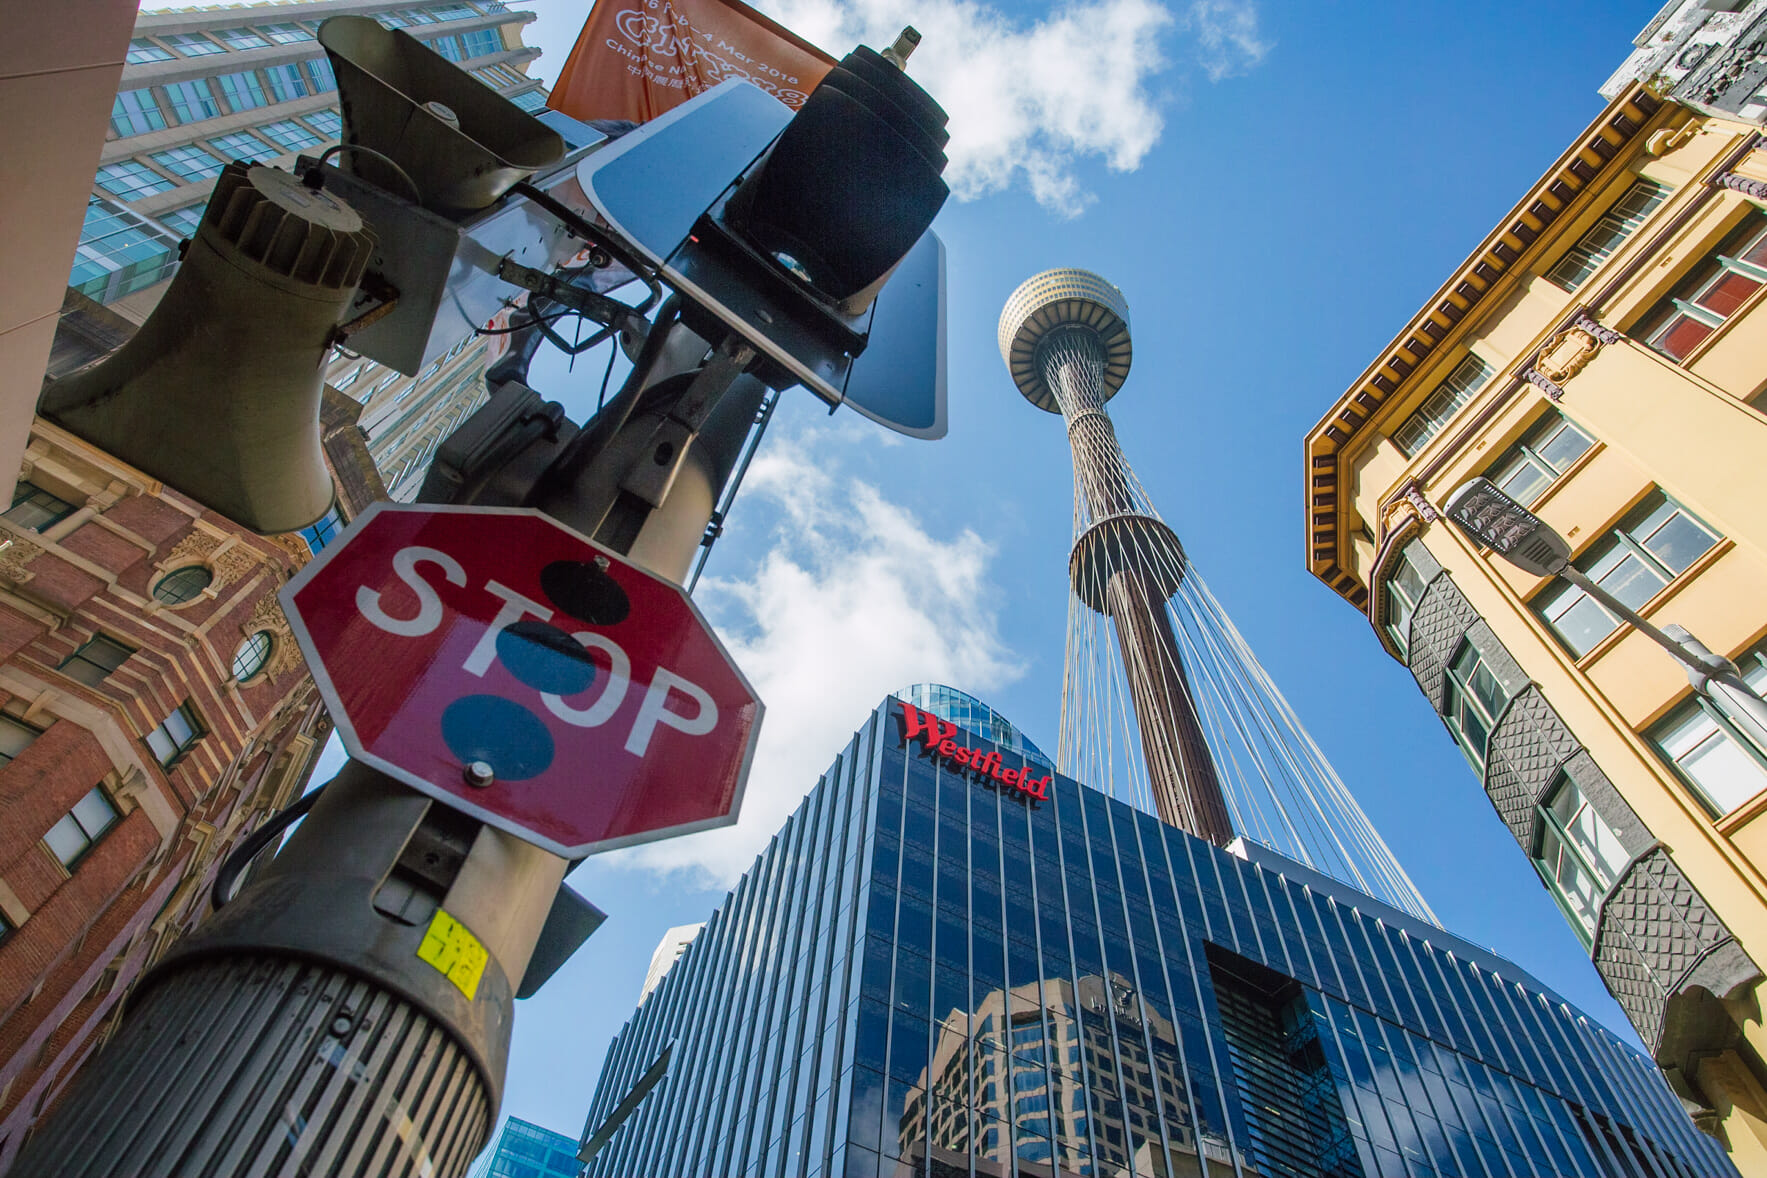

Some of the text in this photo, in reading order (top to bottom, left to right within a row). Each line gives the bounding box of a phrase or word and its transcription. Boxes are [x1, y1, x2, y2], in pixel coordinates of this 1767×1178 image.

[702, 33, 713, 42] 4
[717, 40, 755, 63] Mar
[758, 63, 799, 85] 2018
[355, 546, 719, 758] STOP
[897, 702, 1053, 801] Westfield
